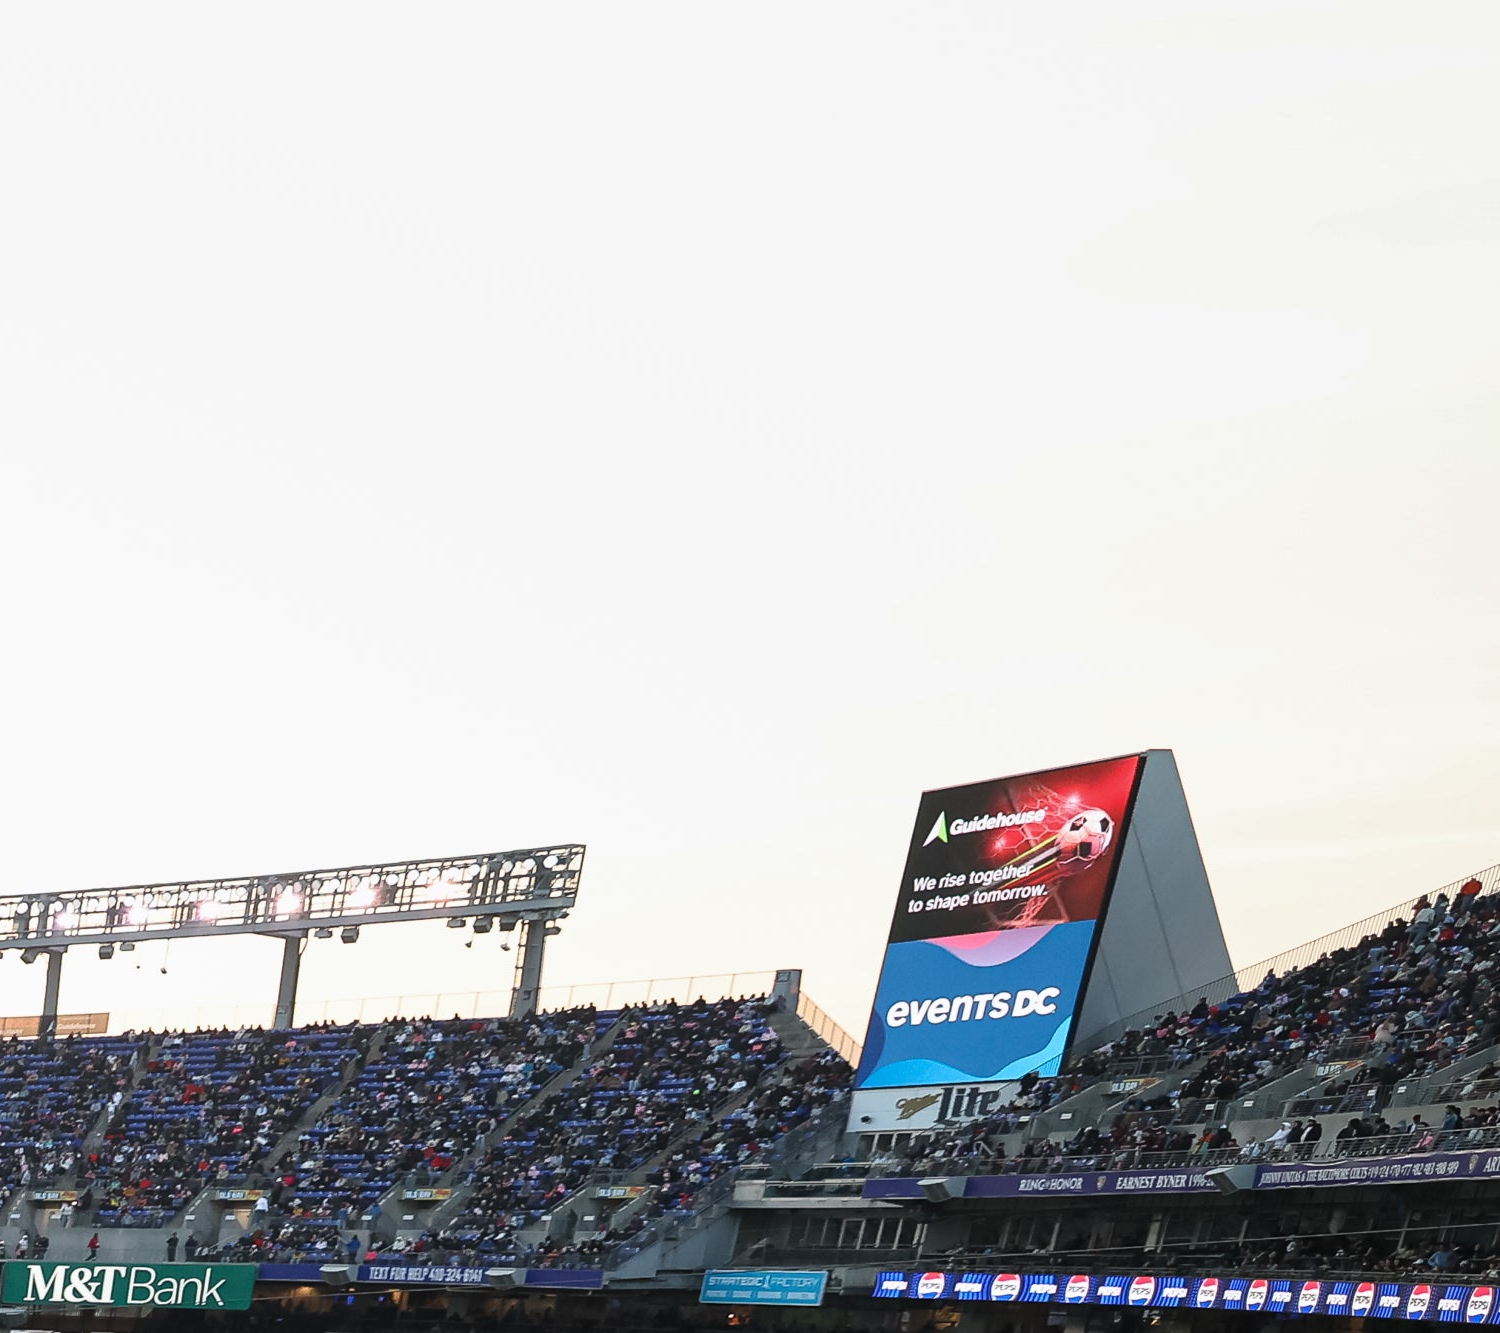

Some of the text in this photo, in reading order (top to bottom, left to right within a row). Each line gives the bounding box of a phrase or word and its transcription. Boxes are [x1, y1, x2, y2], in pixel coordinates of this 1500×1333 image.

[949, 810, 1047, 836] Guidehouse
[912, 863, 1034, 892] We rise together
[907, 882, 1049, 914] to shape tomorrow.
[1116, 1176, 1155, 1190] EARNEST
[1156, 1173, 1188, 1189] BYNER
[23, 1264, 227, 1306] M&T Bank
[708, 1276, 765, 1287] STRATEGIC
